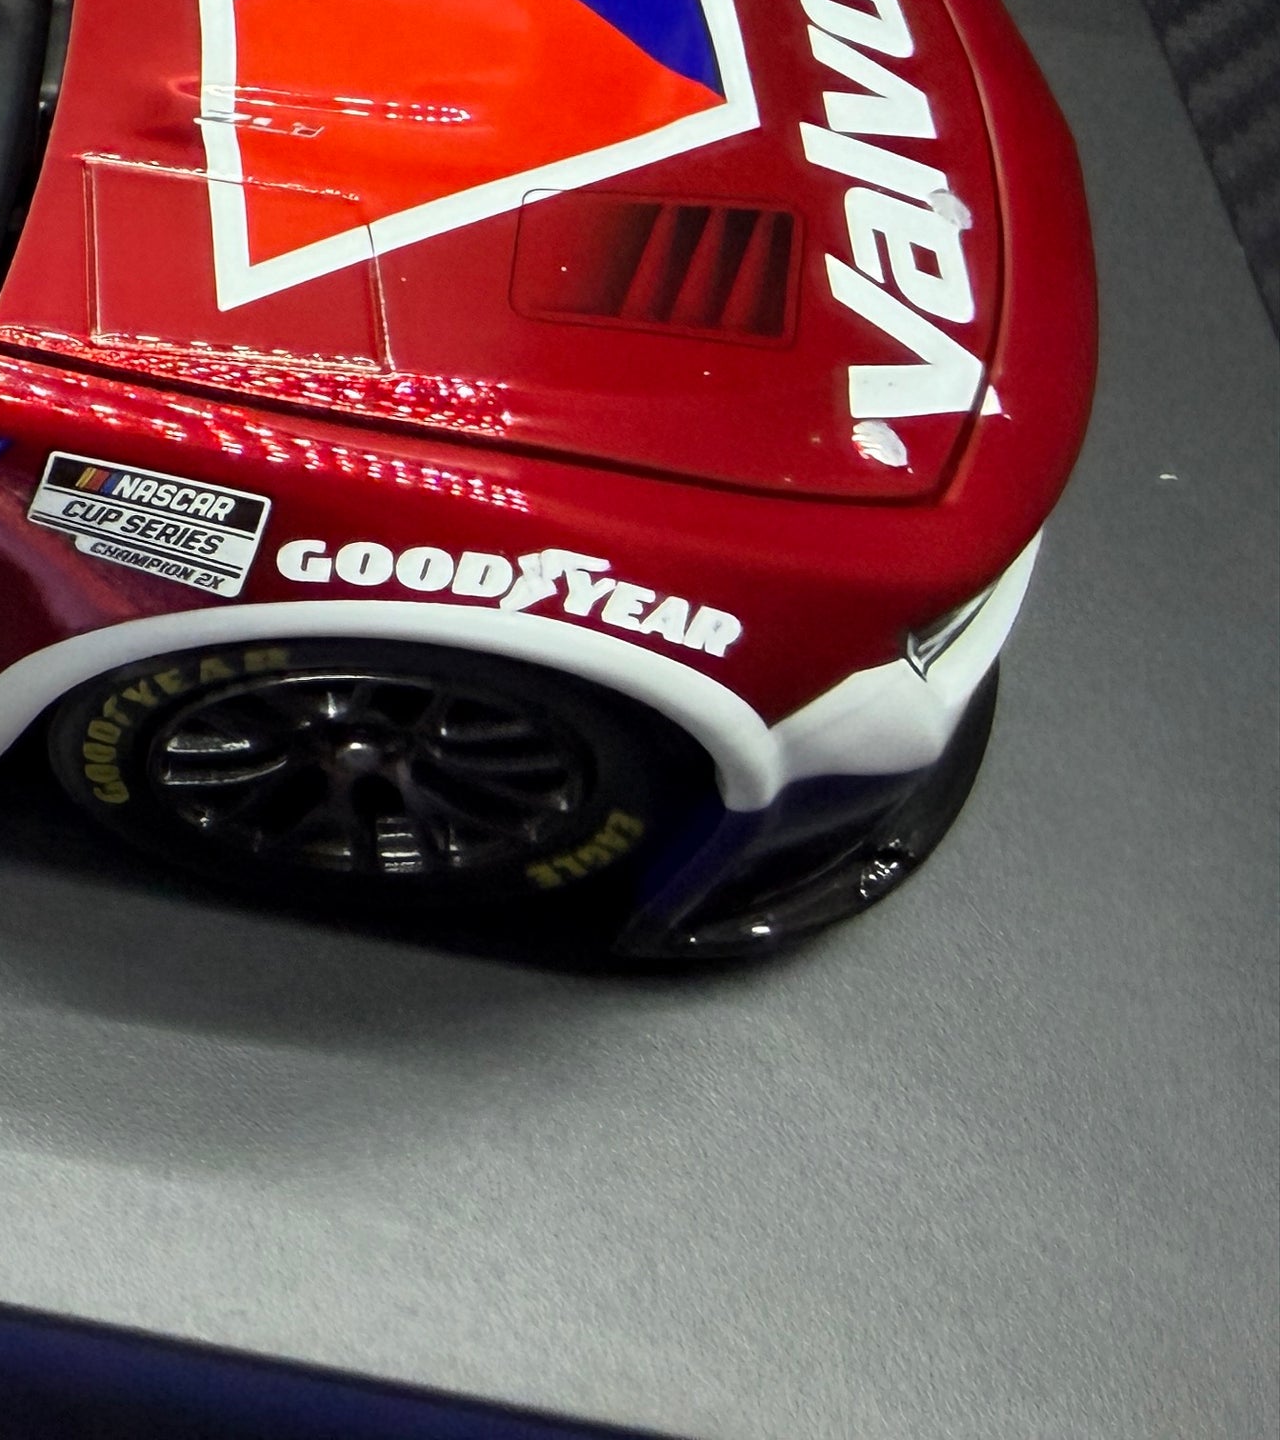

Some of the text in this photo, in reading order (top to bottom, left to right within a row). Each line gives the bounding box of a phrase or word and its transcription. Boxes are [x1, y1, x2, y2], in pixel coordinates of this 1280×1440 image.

[111, 474, 236, 522] NASCAR
[60, 500, 225, 556] CUP SERIES
[90, 542, 227, 591] CHAMPION 2X
[276, 539, 743, 658] GOODYEAR
[83, 647, 288, 804] GOODYEAR
